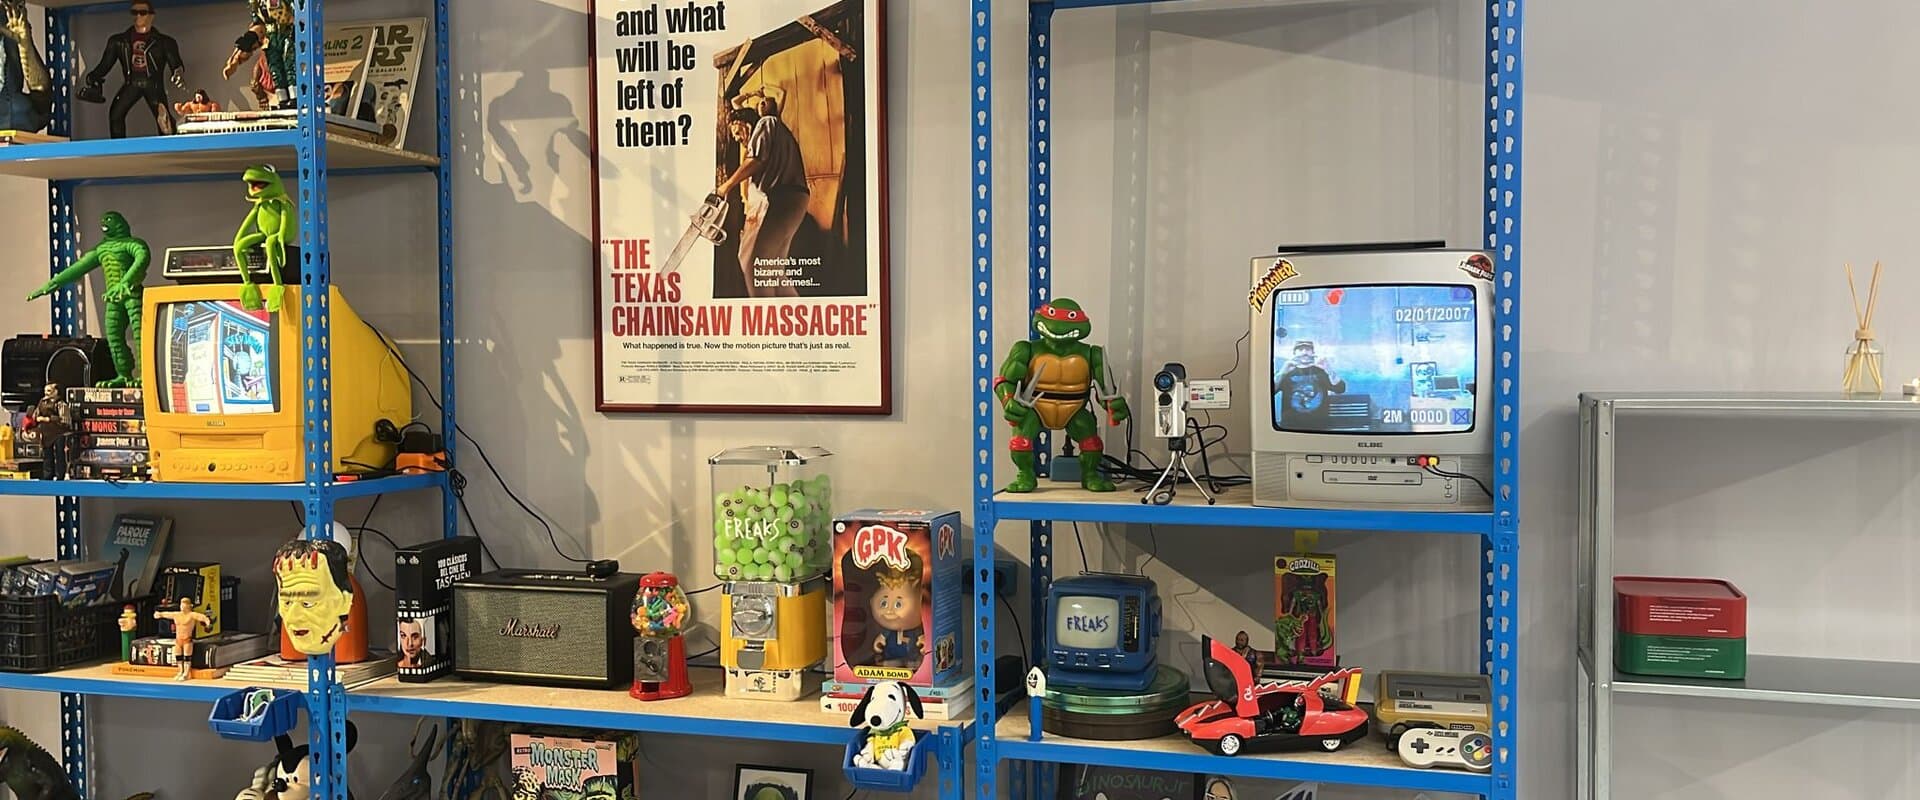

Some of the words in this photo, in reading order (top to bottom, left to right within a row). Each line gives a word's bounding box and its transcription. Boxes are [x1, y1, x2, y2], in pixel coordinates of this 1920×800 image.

[616, 4, 658, 36] and
[665, 1, 725, 33] what
[324, 39, 349, 50] LINS
[351, 34, 363, 50] 2
[374, 25, 414, 45] AR
[370, 45, 413, 68] RS
[616, 41, 659, 73] will
[667, 40, 696, 71] be
[617, 79, 656, 110] left
[661, 77, 684, 109] of
[616, 114, 692, 147] them?
[753, 257, 797, 266] America's
[798, 256, 821, 265] most
[753, 267, 784, 277] bizarre
[786, 267, 803, 276] and
[611, 271, 682, 303] TEXAS
[753, 278, 780, 287] brutal
[1248, 258, 1299, 313] THRASHER
[611, 305, 733, 337] CHAINSAW
[1395, 306, 1472, 322] 02/01/2007
[642, 342, 678, 350] happened
[762, 342, 787, 350] picture
[809, 342, 823, 350] just
[1383, 409, 1403, 423] 2M
[1410, 409, 1444, 423] 0000
[116, 526, 151, 538] PARQUE
[724, 517, 781, 542] FREAKS
[856, 527, 905, 566] GPK
[938, 524, 955, 559] GPK
[499, 617, 560, 639] Marshall
[1066, 615, 1109, 633] FREAKS
[857, 669, 885, 677] ADAM
[529, 742, 599, 773] MONSTER
[545, 765, 582, 788] MASK
